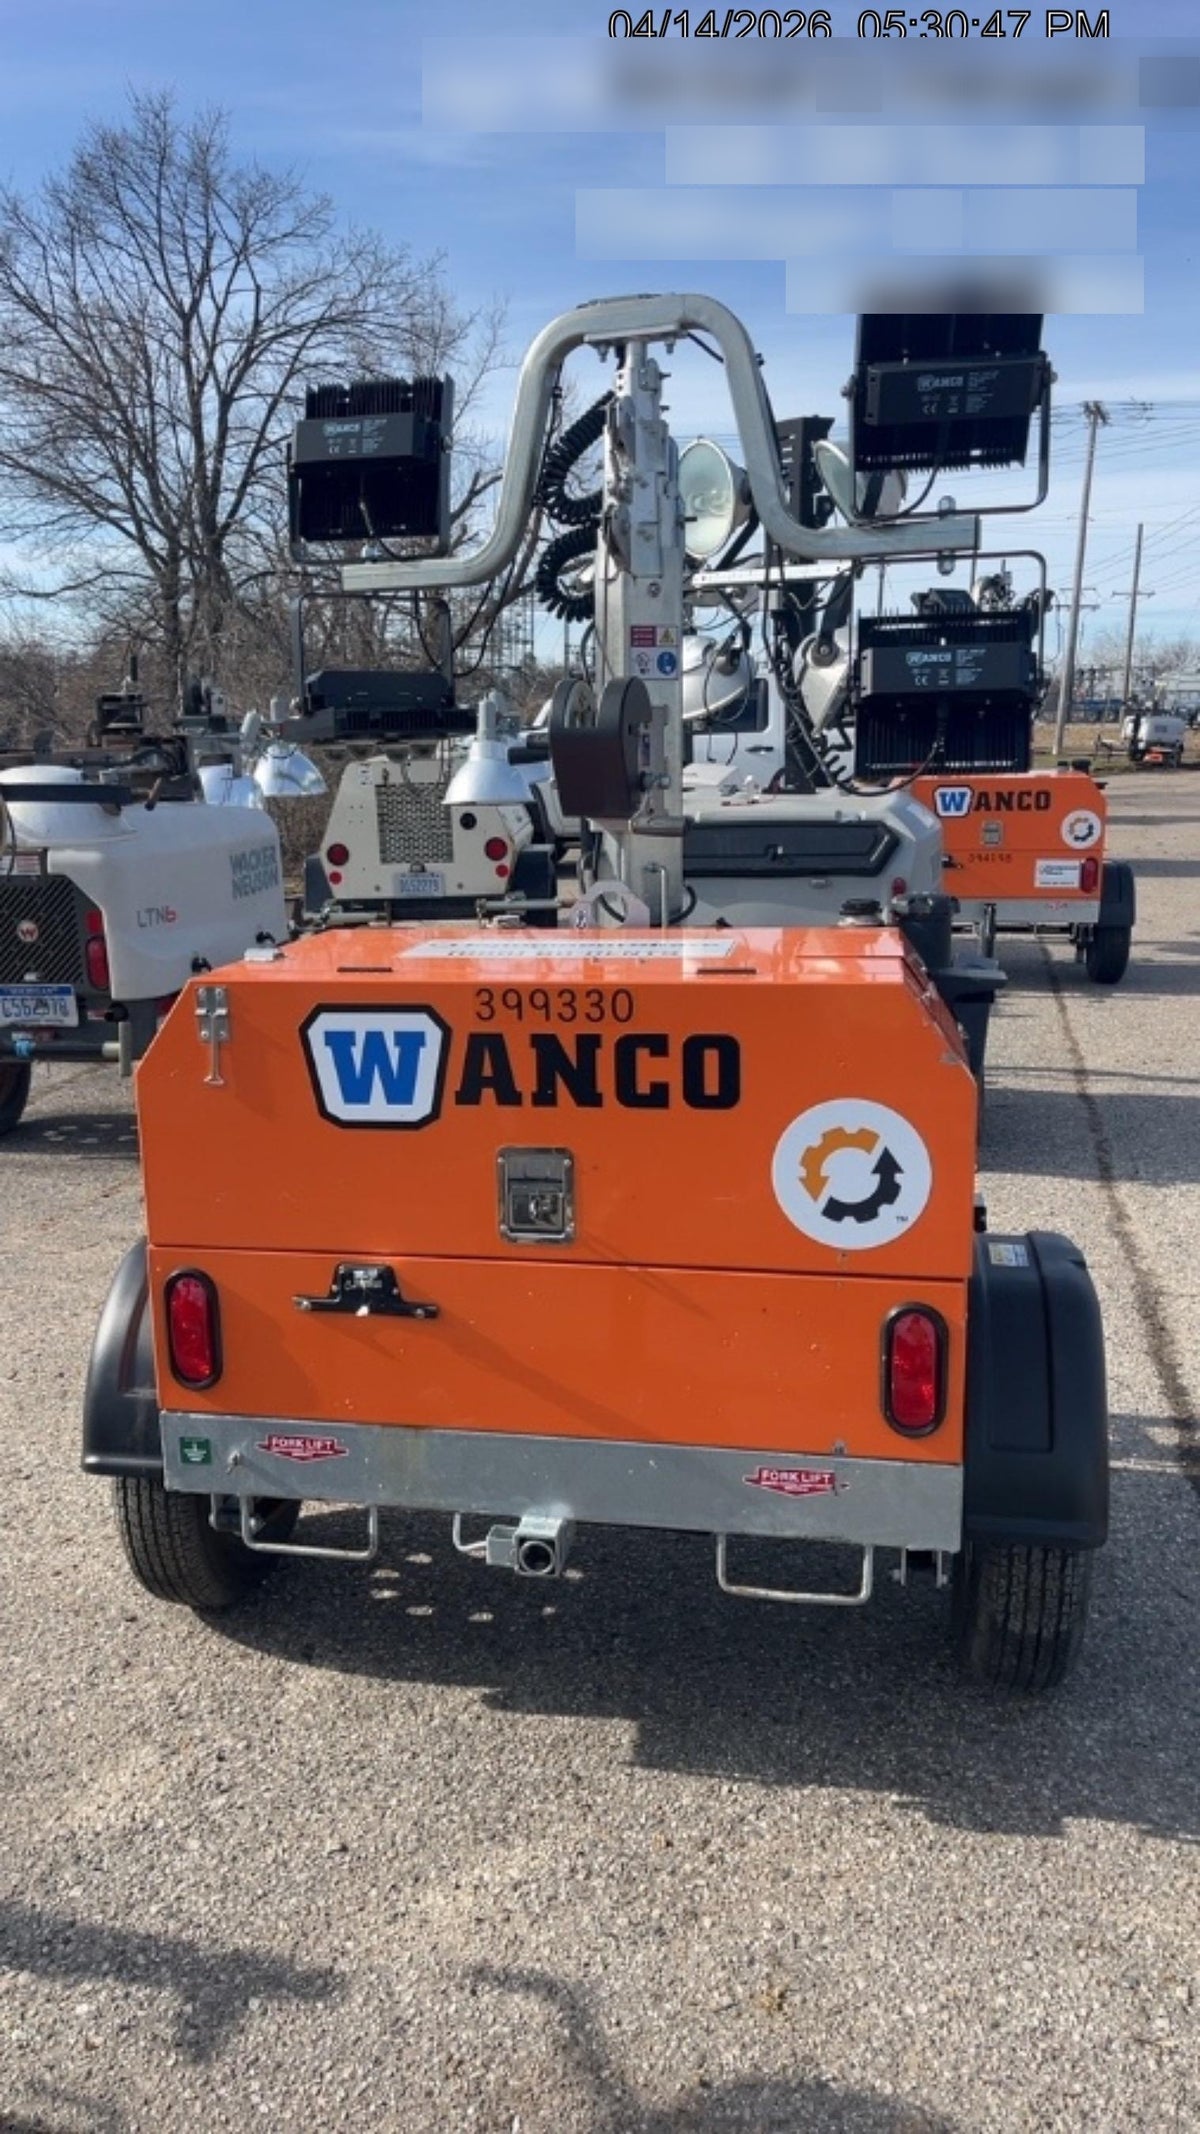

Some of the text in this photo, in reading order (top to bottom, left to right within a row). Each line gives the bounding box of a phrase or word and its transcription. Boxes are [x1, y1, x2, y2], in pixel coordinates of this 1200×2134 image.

[936, 787, 1051, 815] WANCO
[475, 988, 634, 1022] 399330
[318, 1026, 741, 1112] WANCO
[271, 1437, 304, 1449] FORK
[761, 1469, 831, 1484] FORK LIFT
